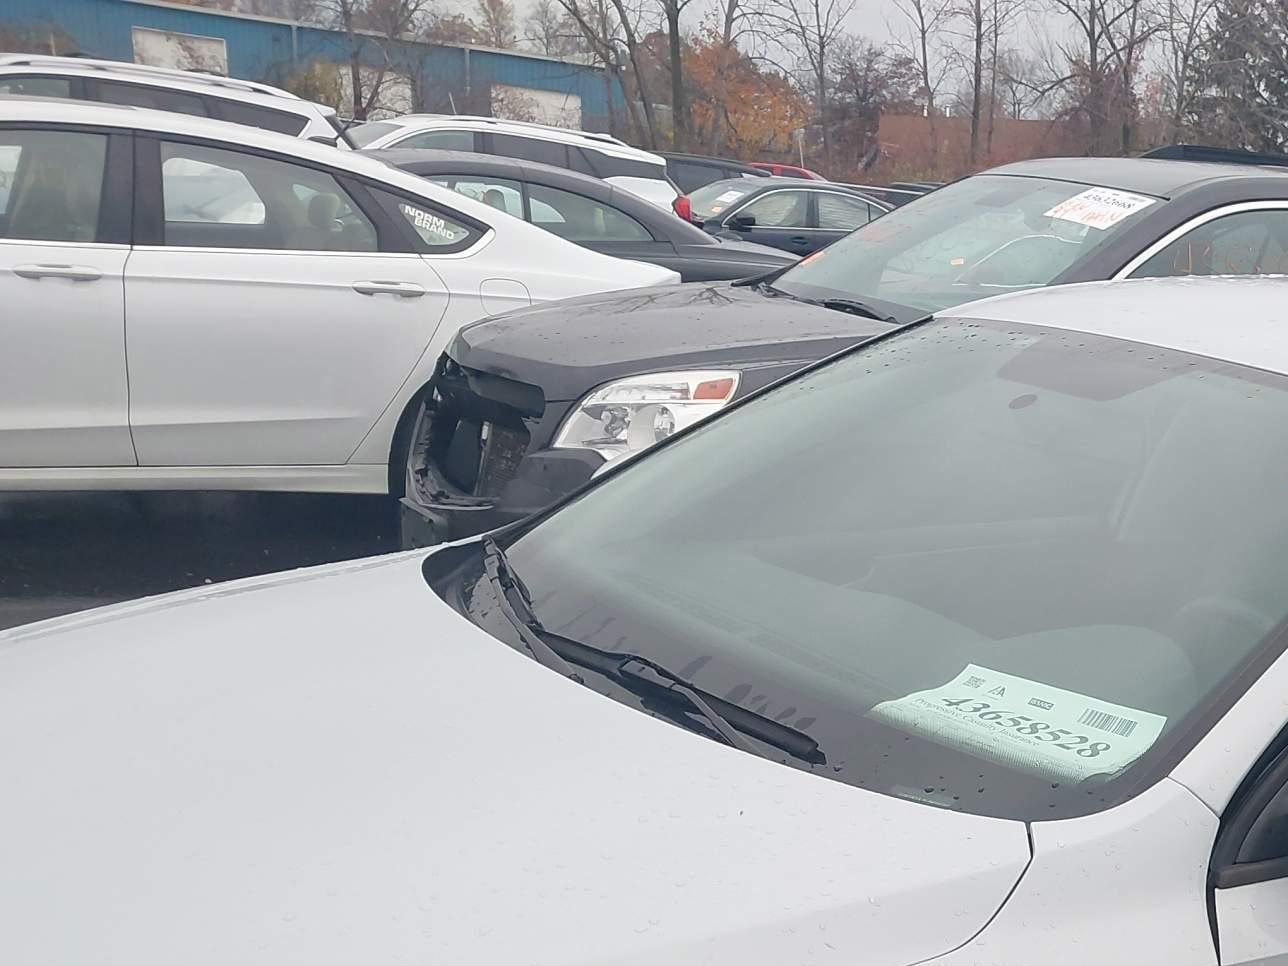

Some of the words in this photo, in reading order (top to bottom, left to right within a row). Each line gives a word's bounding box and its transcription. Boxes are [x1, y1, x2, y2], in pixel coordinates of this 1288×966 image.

[404, 205, 445, 228] NORM
[414, 217, 455, 240] BRAND
[941, 697, 1111, 758] 43658528
